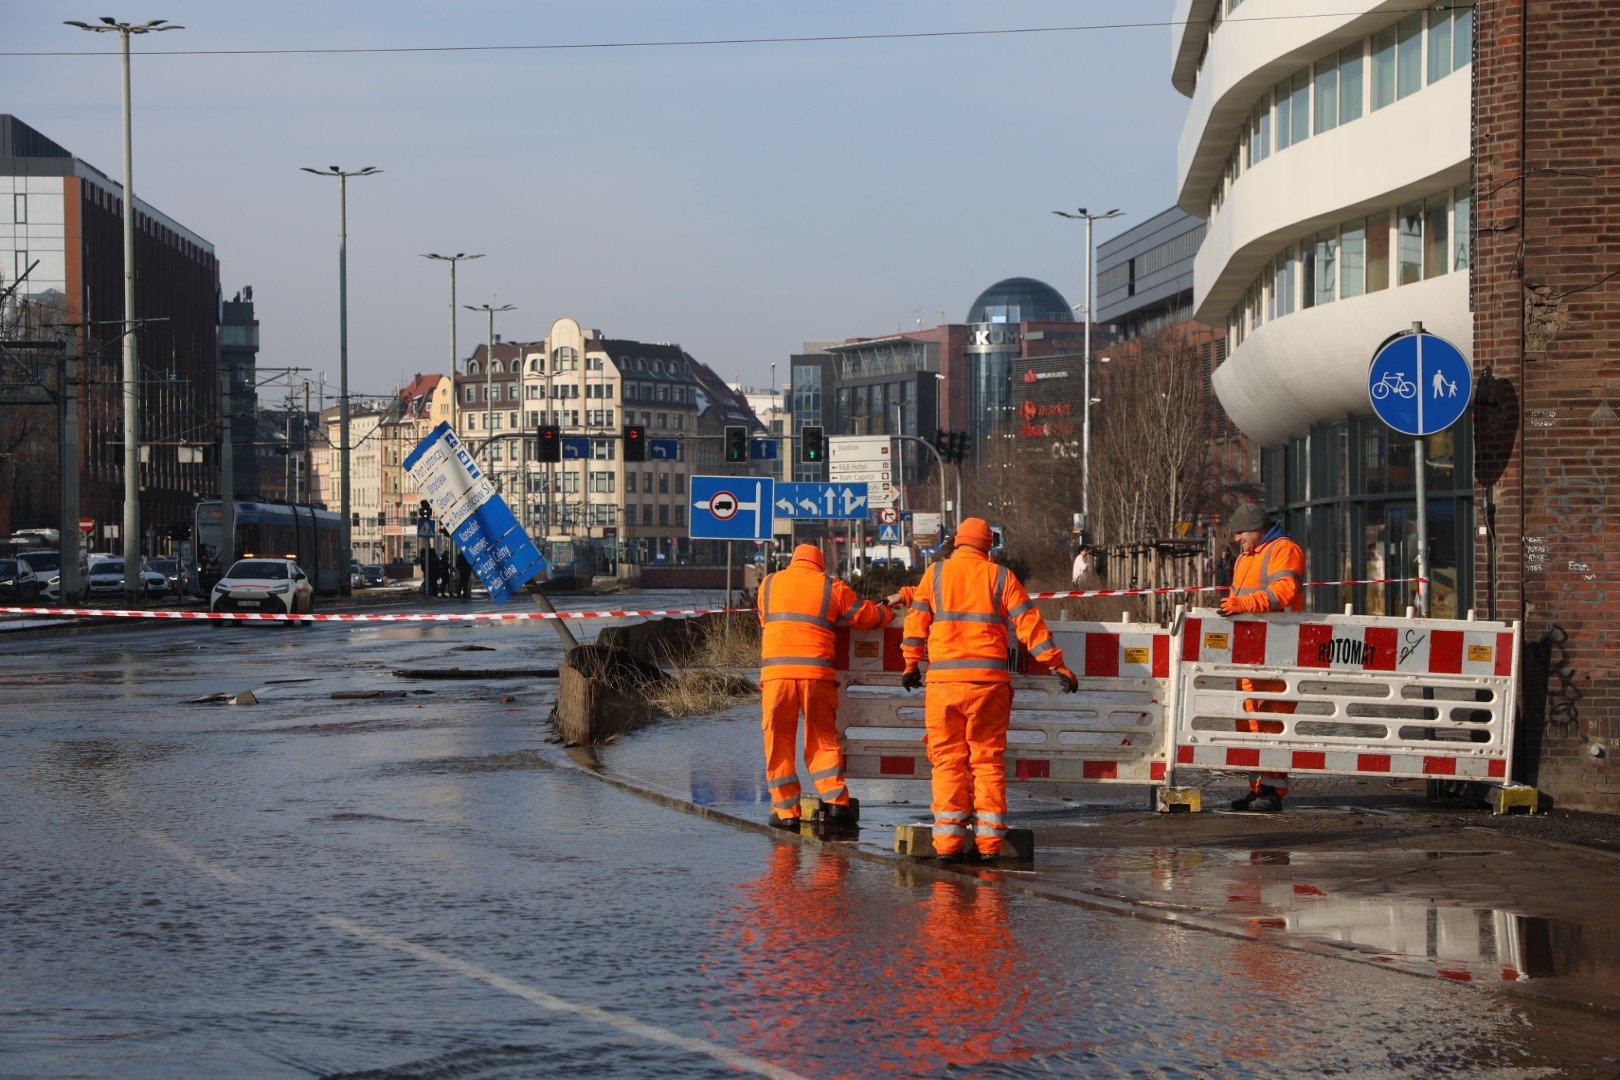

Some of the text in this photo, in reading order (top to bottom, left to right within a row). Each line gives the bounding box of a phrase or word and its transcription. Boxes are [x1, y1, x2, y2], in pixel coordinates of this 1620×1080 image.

[414, 447, 445, 479] Port Lotniczy
[851, 463, 868, 471] Hotel
[426, 472, 448, 495] Wrocław
[854, 473, 875, 482] Capitol
[451, 490, 485, 520] Powstańców
[459, 519, 481, 543] Konsulat
[467, 537, 489, 557] Niemiec
[480, 545, 512, 575] Urząd Celny
[490, 564, 518, 590] Izba Celna
[1318, 638, 1376, 665] ROTOMAT
